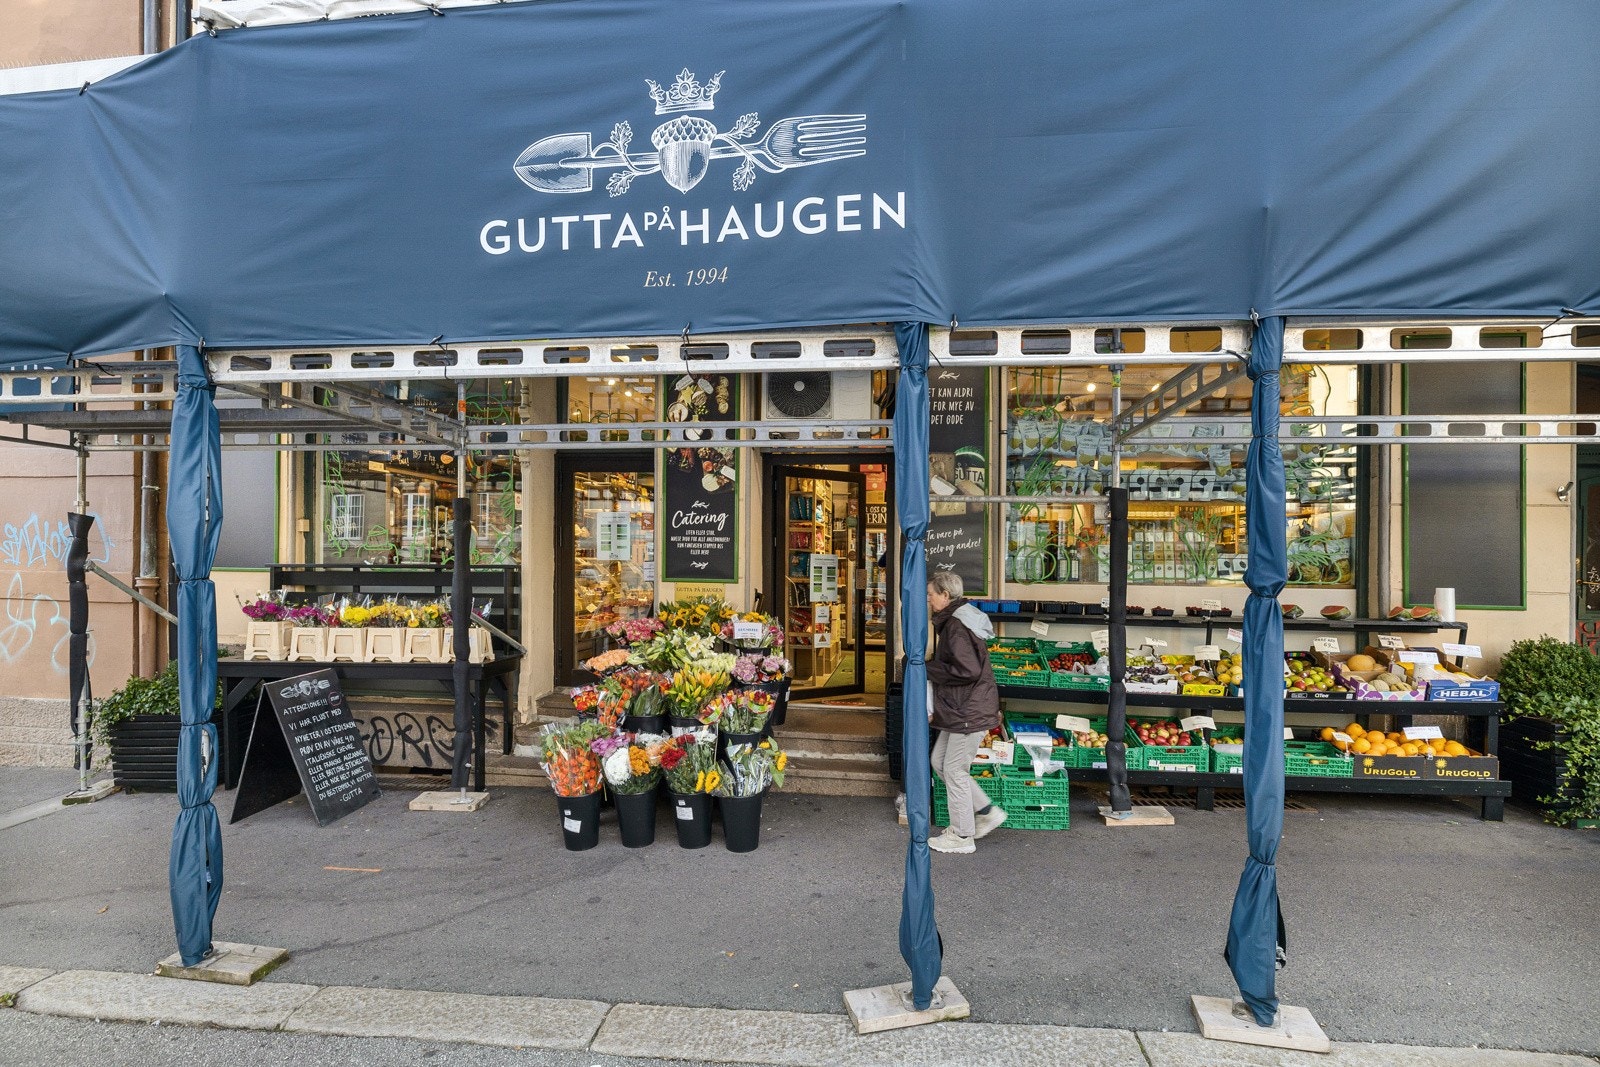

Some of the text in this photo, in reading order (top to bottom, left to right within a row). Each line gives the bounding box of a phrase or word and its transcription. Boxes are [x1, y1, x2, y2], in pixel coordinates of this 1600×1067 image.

[480, 191, 907, 255] GUTTA PÅ HAUGEN
[644, 266, 728, 288] Est. 1994
[938, 387, 952, 398] KAN
[954, 387, 973, 398] ALDRI
[933, 400, 975, 412] FOR MYE AV
[930, 414, 964, 424] DET GODE
[672, 510, 730, 532] Catering
[926, 527, 964, 542] Ta vare på
[930, 544, 945, 555] selv
[946, 544, 956, 558] og
[956, 538, 982, 550] andre!
[288, 723, 297, 731] VI
[299, 719, 312, 728] HAR
[331, 708, 342, 717] MED
[294, 730, 321, 744] NYHETER
[324, 721, 357, 734] OSTEDISKEN
[299, 745, 314, 756] PRØV
[314, 742, 323, 751] EN
[323, 740, 331, 749] AV
[304, 748, 336, 766] ITALIENSKE
[308, 764, 324, 776] ELLER
[311, 772, 326, 784] ELLER
[315, 780, 330, 792] ELLER
[330, 776, 340, 785] NOE
[340, 771, 351, 780] HELT
[318, 792, 326, 801] DU
